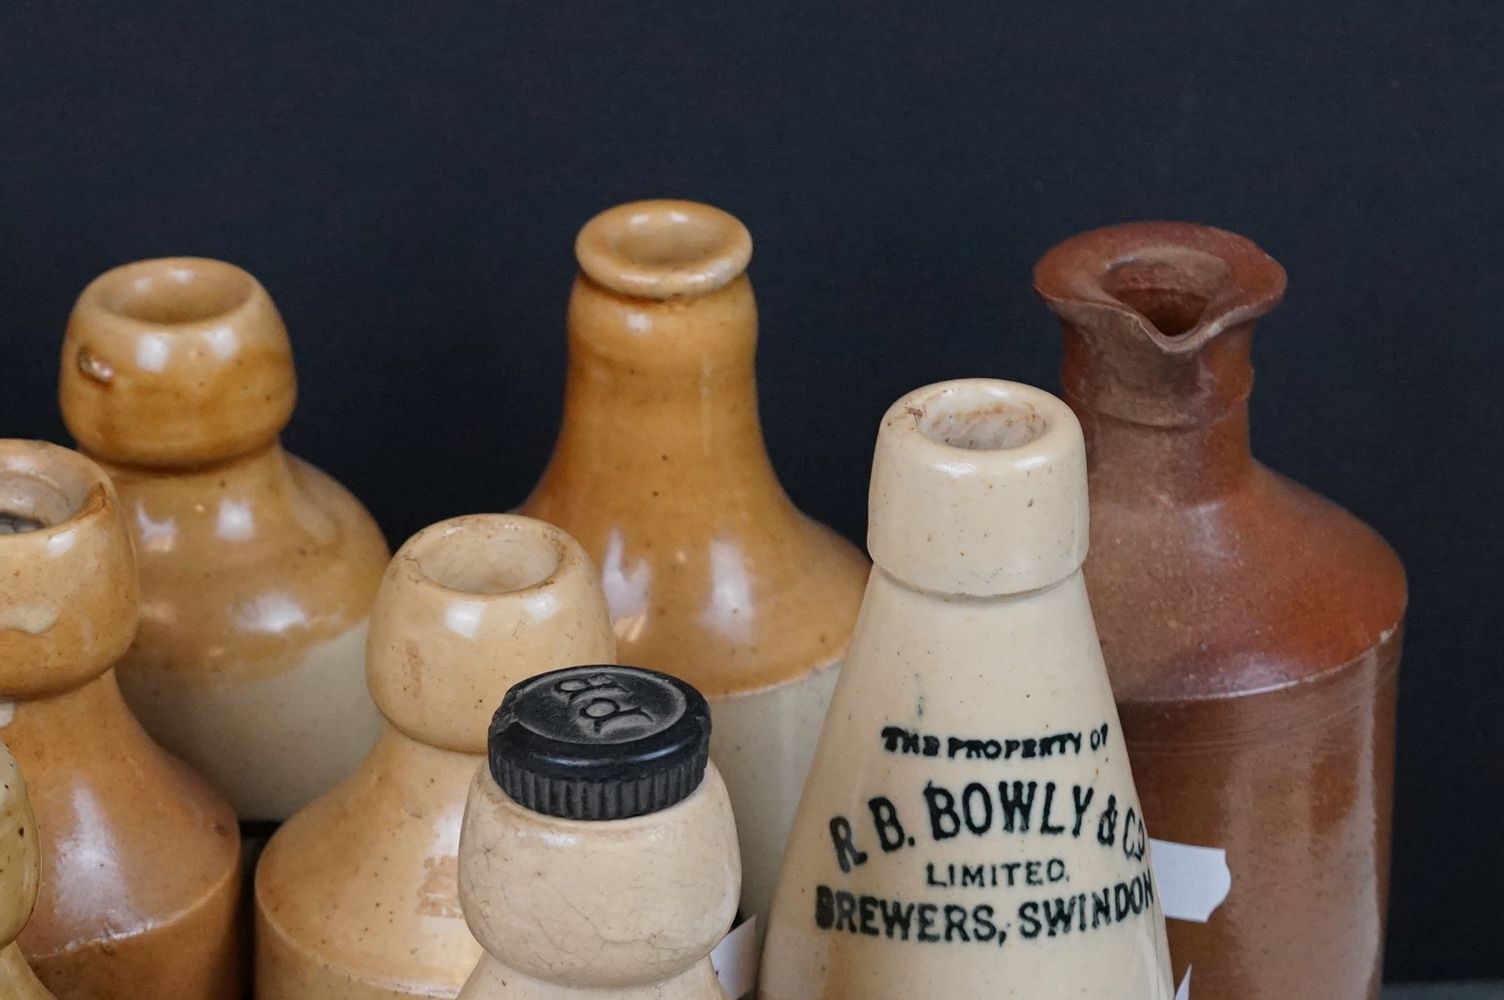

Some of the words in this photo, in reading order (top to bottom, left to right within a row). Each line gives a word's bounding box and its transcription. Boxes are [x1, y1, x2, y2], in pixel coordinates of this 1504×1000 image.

[881, 725, 941, 757] THE
[947, 731, 1083, 761] PROPERTY
[923, 779, 1094, 841] BOWLY
[1097, 794, 1119, 847] &
[815, 885, 1007, 947] BREWERS,
[1016, 868, 1156, 938] SWINDON
